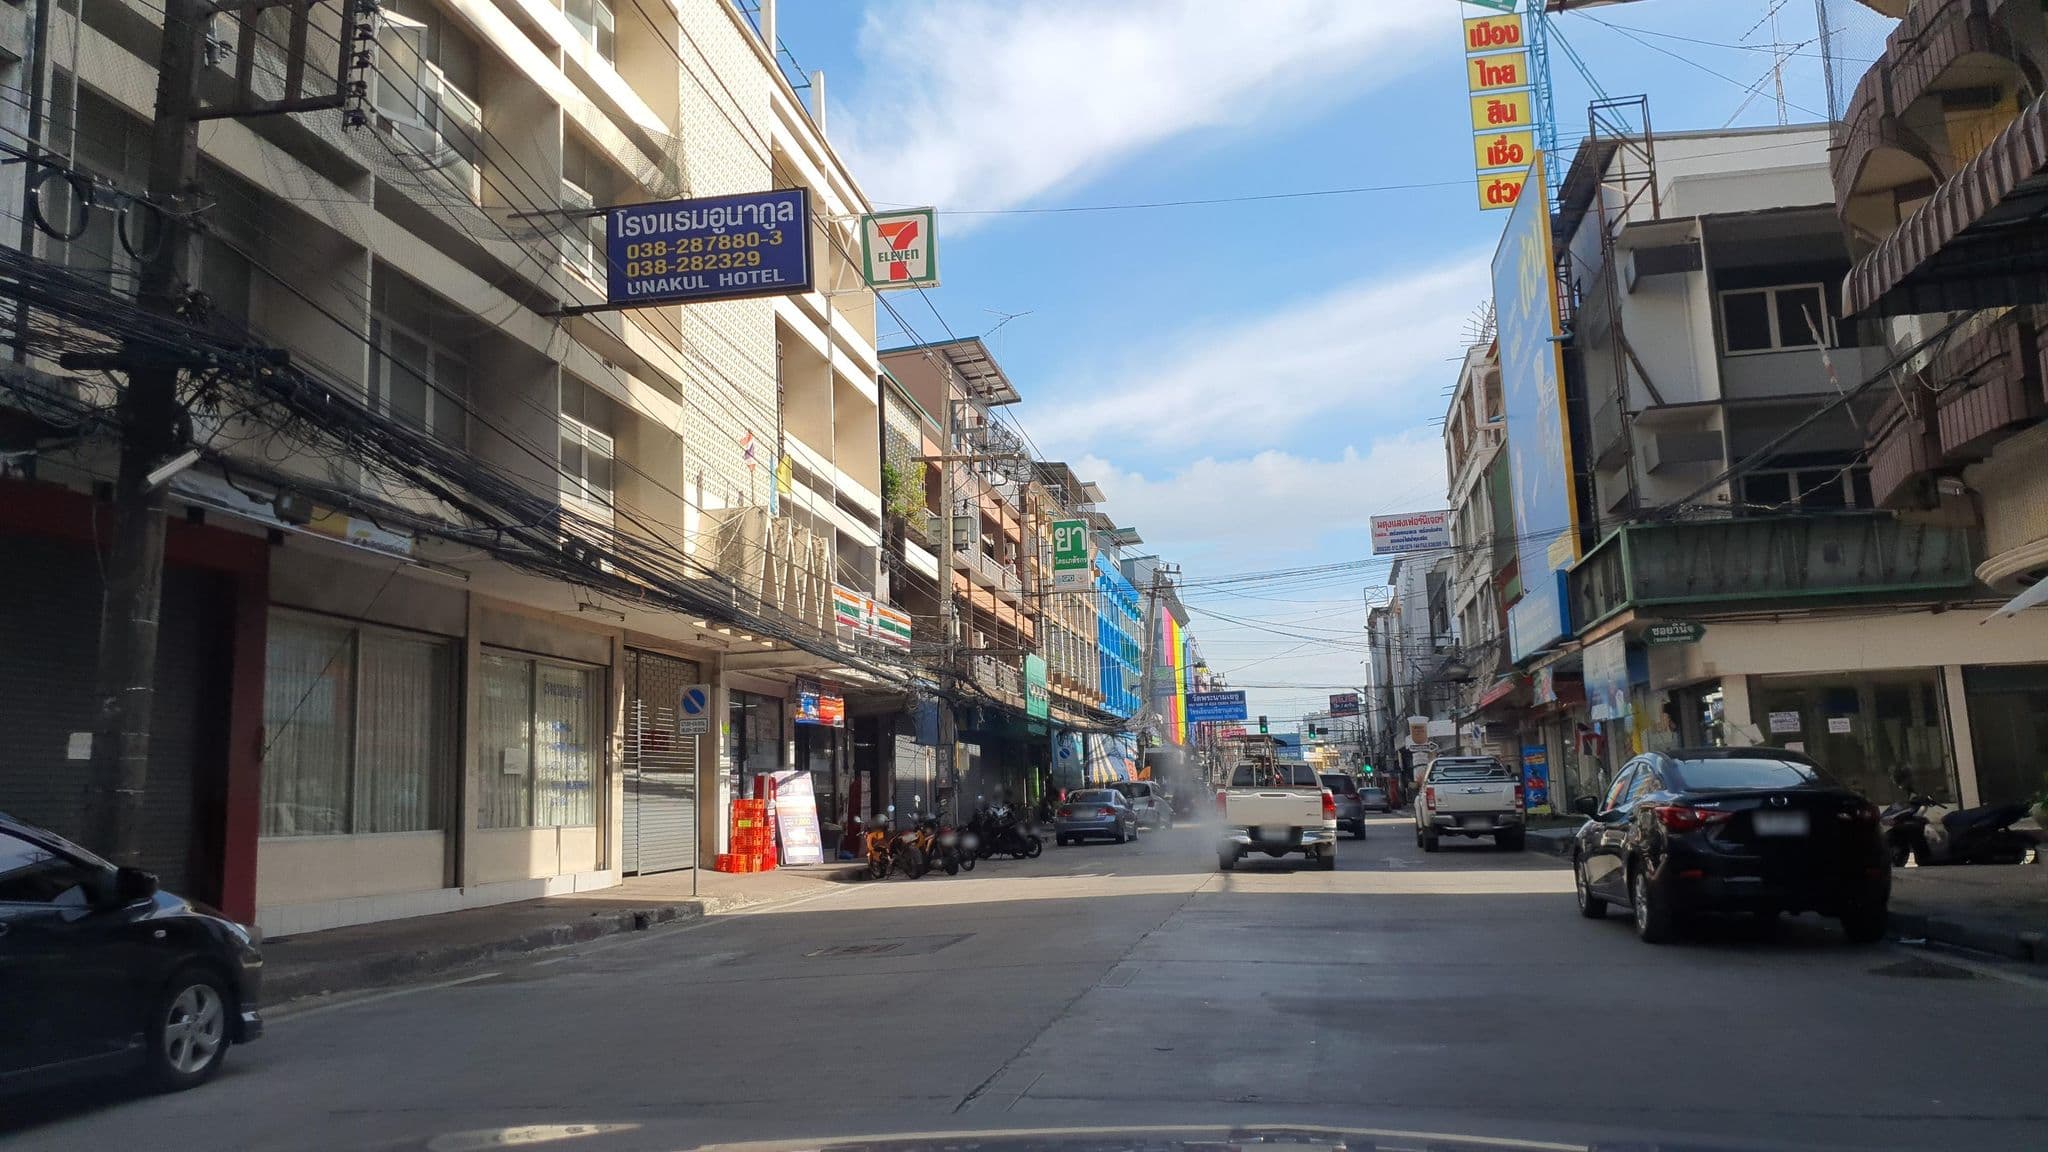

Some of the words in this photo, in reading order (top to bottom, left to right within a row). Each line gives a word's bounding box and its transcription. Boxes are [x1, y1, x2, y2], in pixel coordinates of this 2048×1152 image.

[1469, 21, 1519, 48] เมือง
[1475, 59, 1516, 87] ไทย
[1487, 100, 1517, 124] สิน
[1487, 135, 1523, 166] เชื่อ
[1486, 179, 1522, 204] ด่ว
[616, 200, 794, 238] โรงแรมอูนากูล
[627, 230, 783, 259] 038-287880-3
[878, 220, 918, 280] 7
[627, 251, 761, 277] 038-282329
[628, 275, 709, 295] UNAKUL
[719, 268, 785, 286] HOTEL
[1055, 526, 1086, 552] ยา
